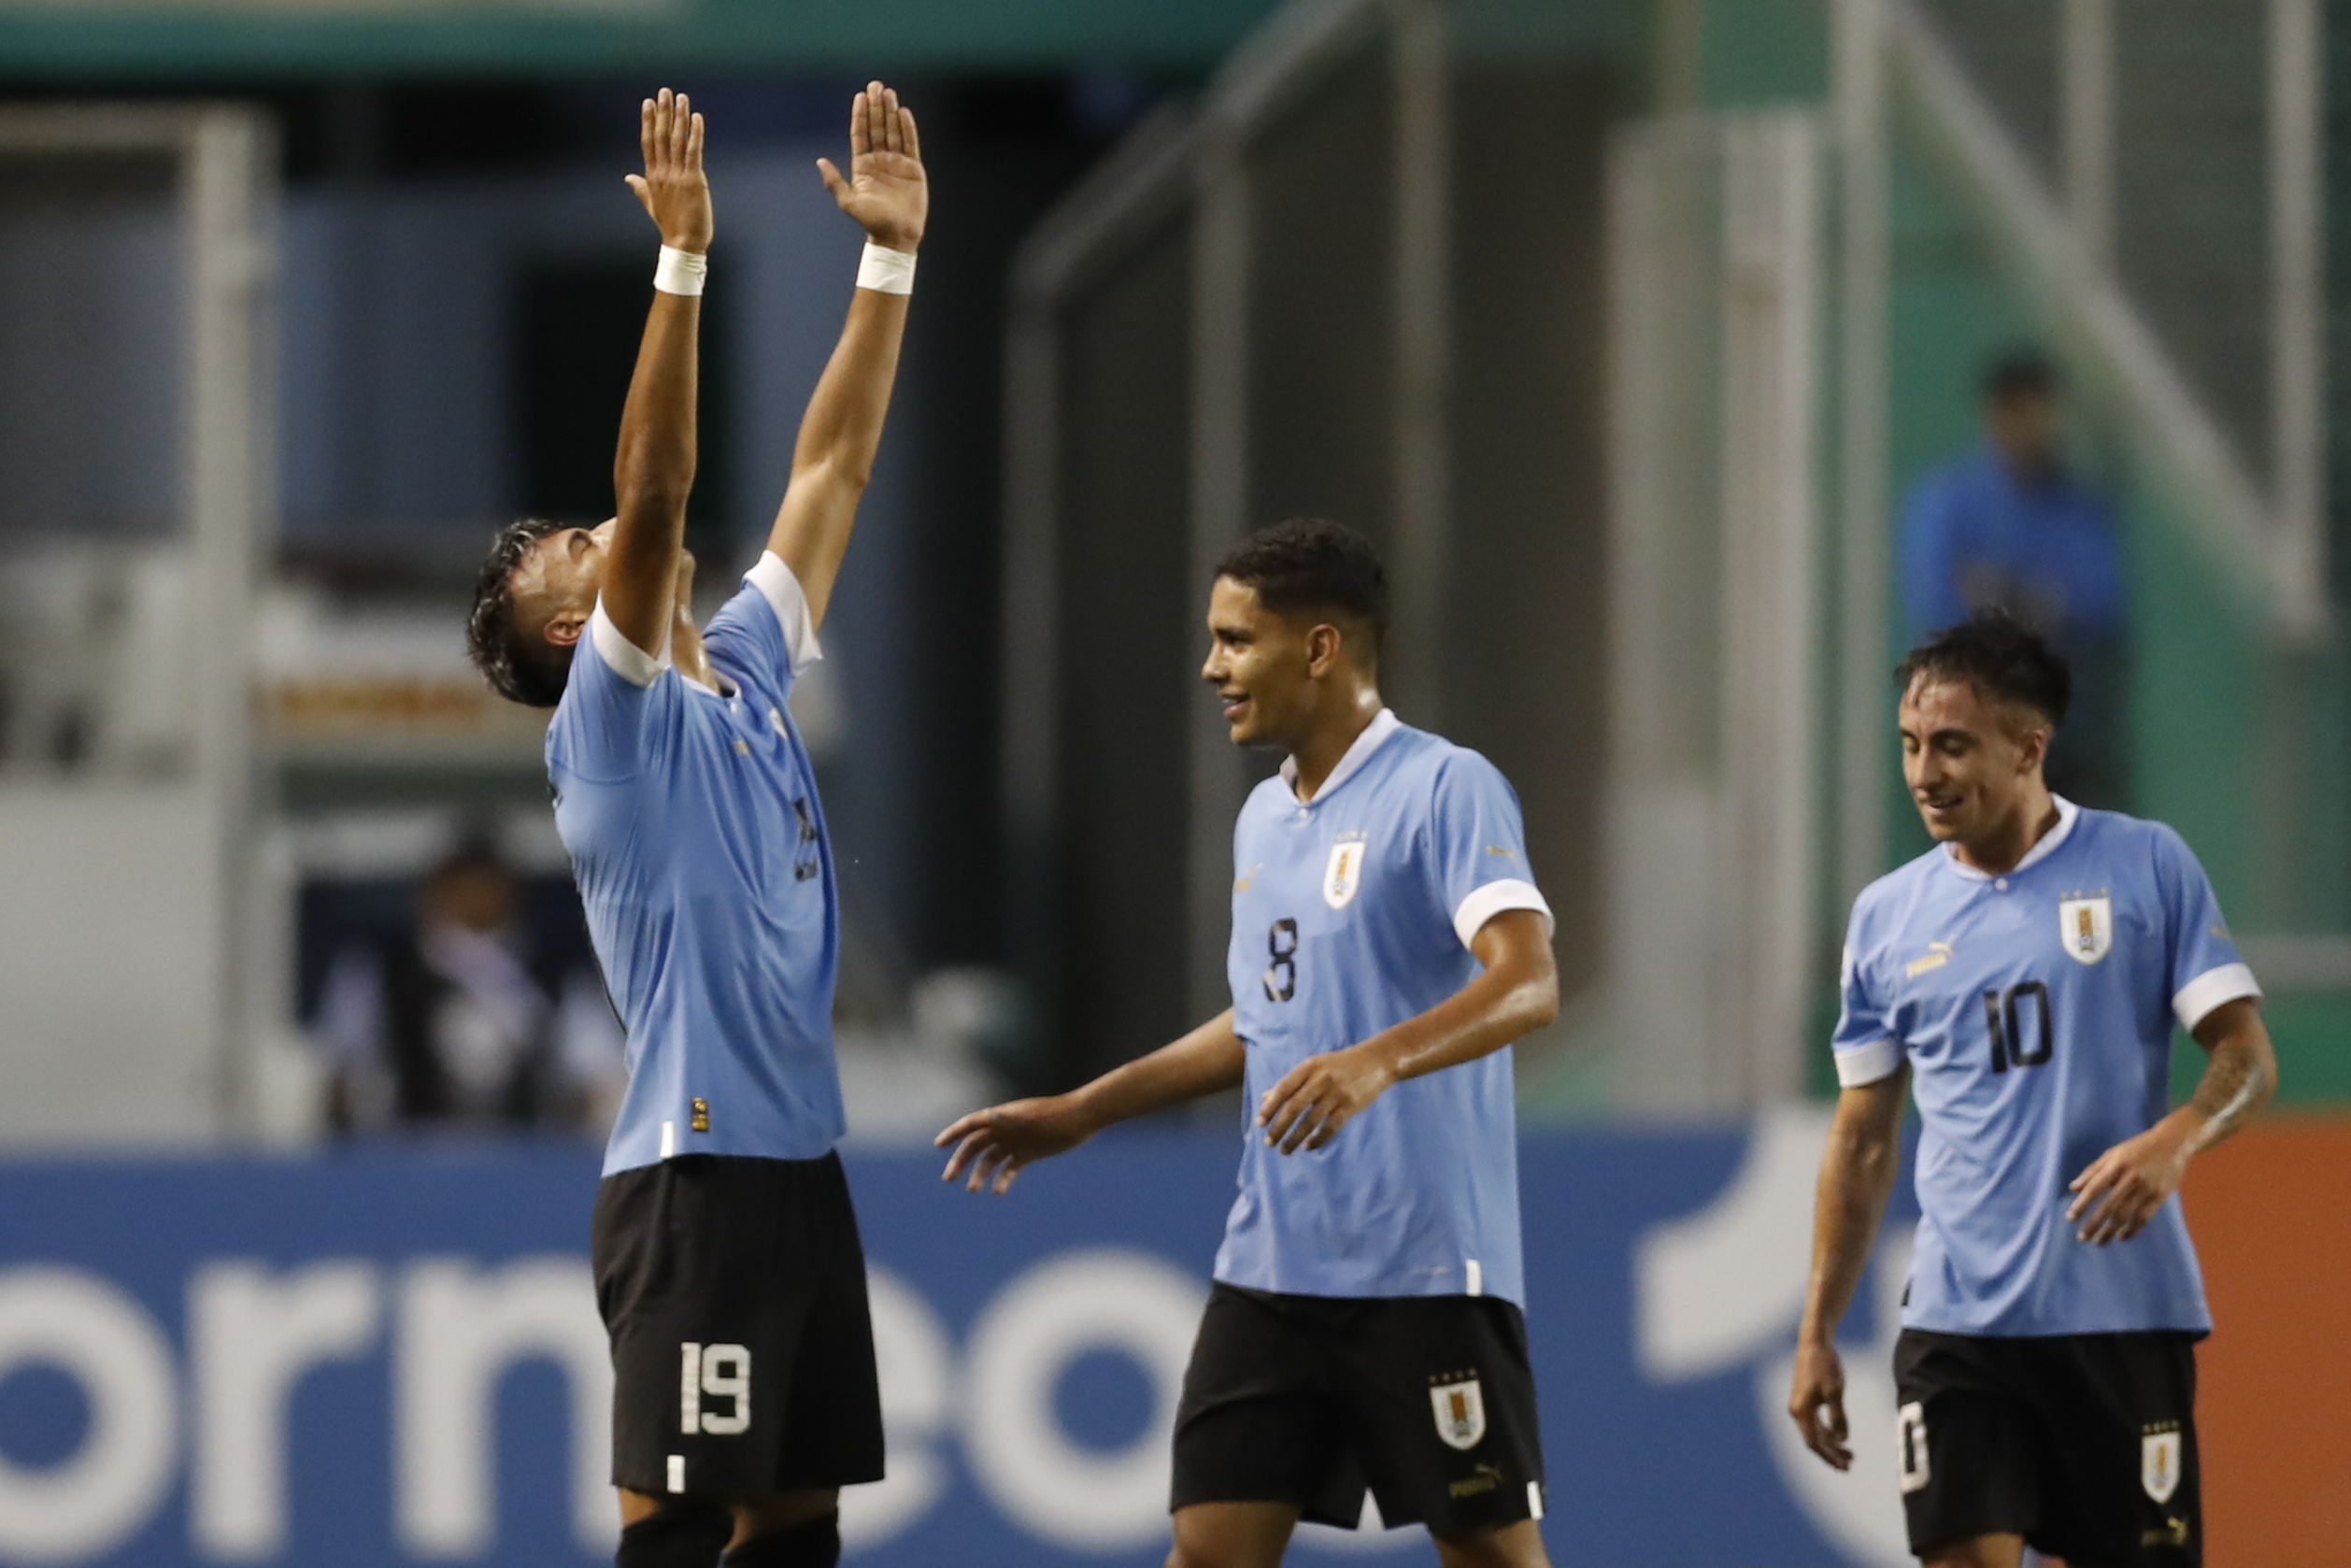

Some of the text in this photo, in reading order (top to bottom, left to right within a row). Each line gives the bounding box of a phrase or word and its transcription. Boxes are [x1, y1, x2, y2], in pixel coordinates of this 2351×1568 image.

[1263, 915, 1299, 1003] 8
[1982, 980, 2052, 1073] 10
[680, 1341, 751, 1435] 19
